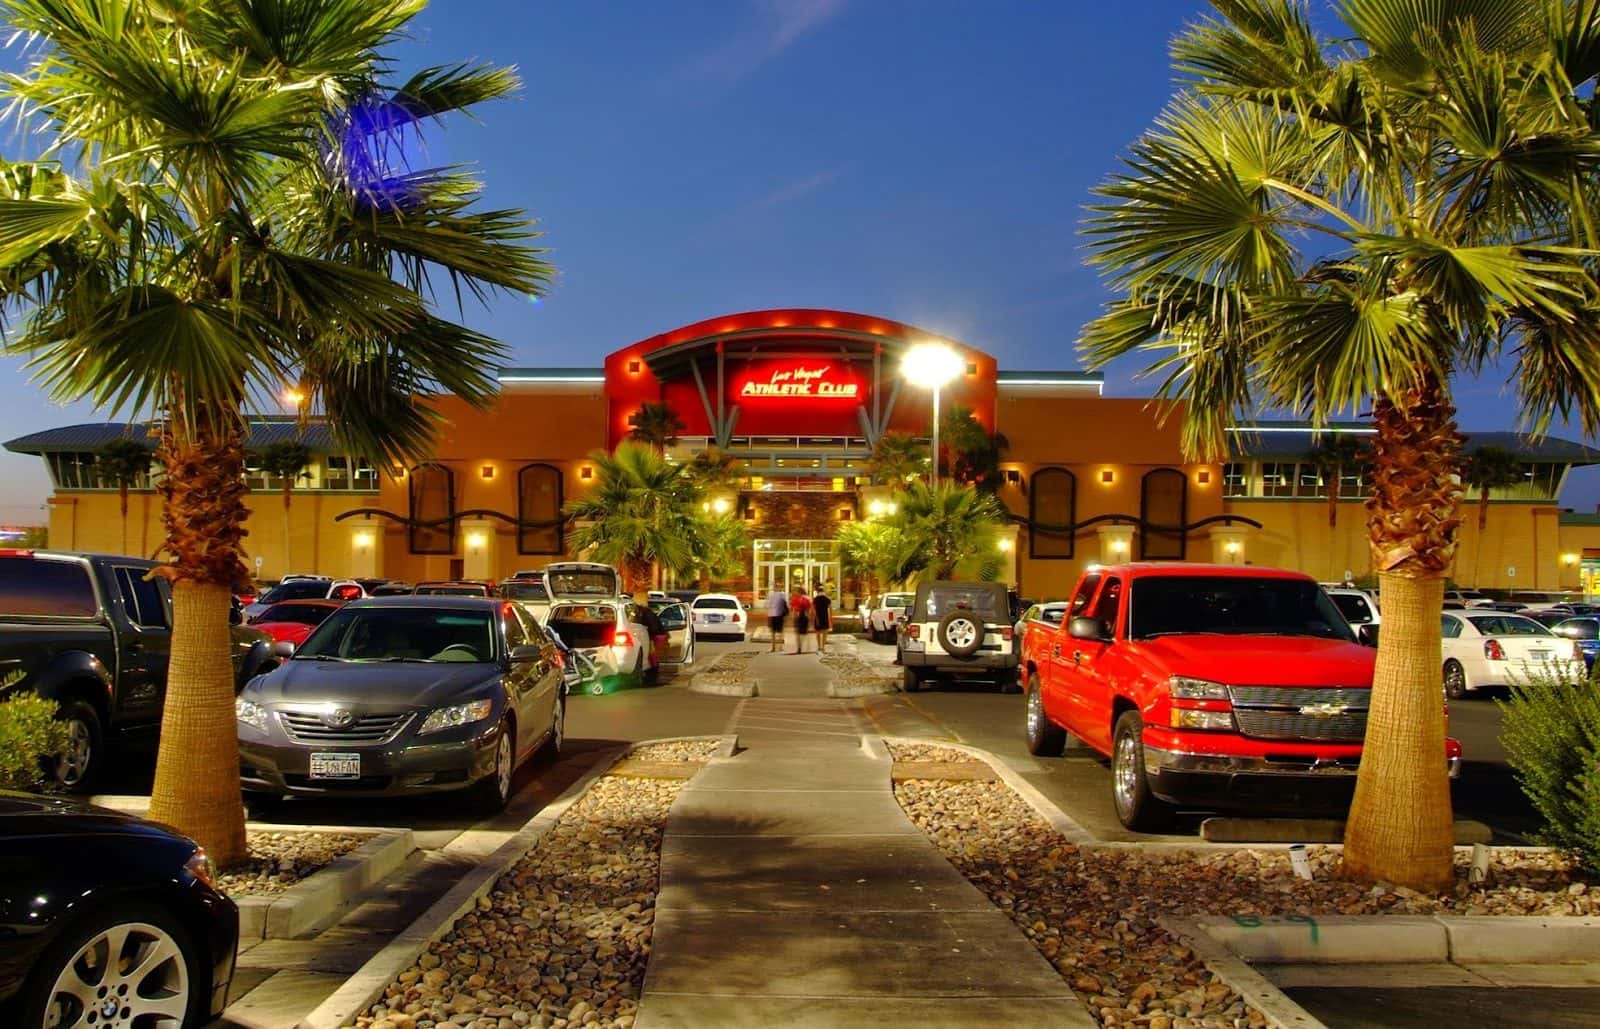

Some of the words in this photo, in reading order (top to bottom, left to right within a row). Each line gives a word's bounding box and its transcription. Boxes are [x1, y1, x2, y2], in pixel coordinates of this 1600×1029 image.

[770, 370, 793, 385] Las
[793, 366, 832, 385] Vegas
[741, 381, 813, 395] ATHLETIC
[817, 382, 859, 395] CLUB
